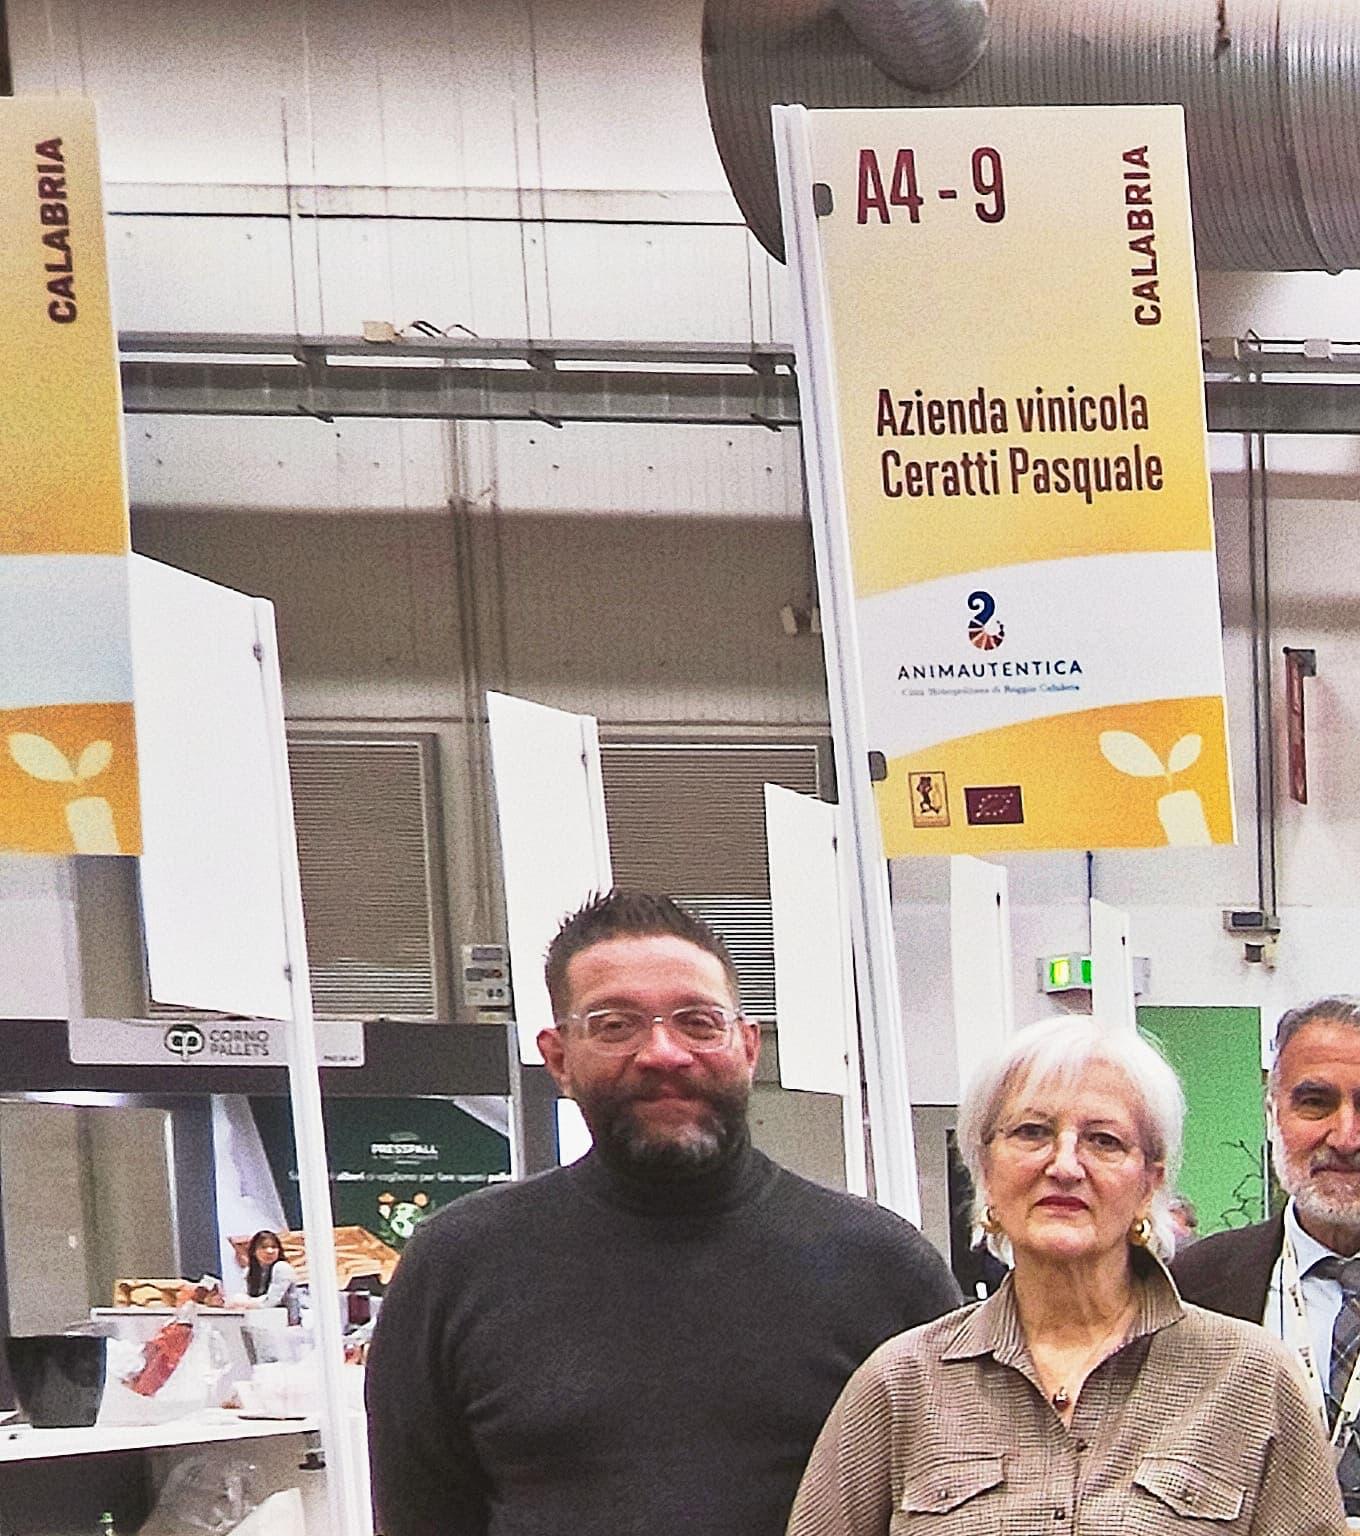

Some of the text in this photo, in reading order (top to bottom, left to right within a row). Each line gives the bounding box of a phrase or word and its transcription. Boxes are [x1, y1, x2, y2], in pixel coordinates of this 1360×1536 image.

[857, 147, 1006, 225] A4 - 9
[35, 137, 77, 325] CALABRIA
[1122, 145, 1162, 326] CALABRIA
[876, 384, 1149, 437] Azienda vinicola
[881, 444, 1164, 505] Ceratti Pasquale
[897, 659, 1084, 681] ANIMAUTENTICA
[210, 1030, 269, 1041] CORNO
[210, 1044, 269, 1056] PALLETS
